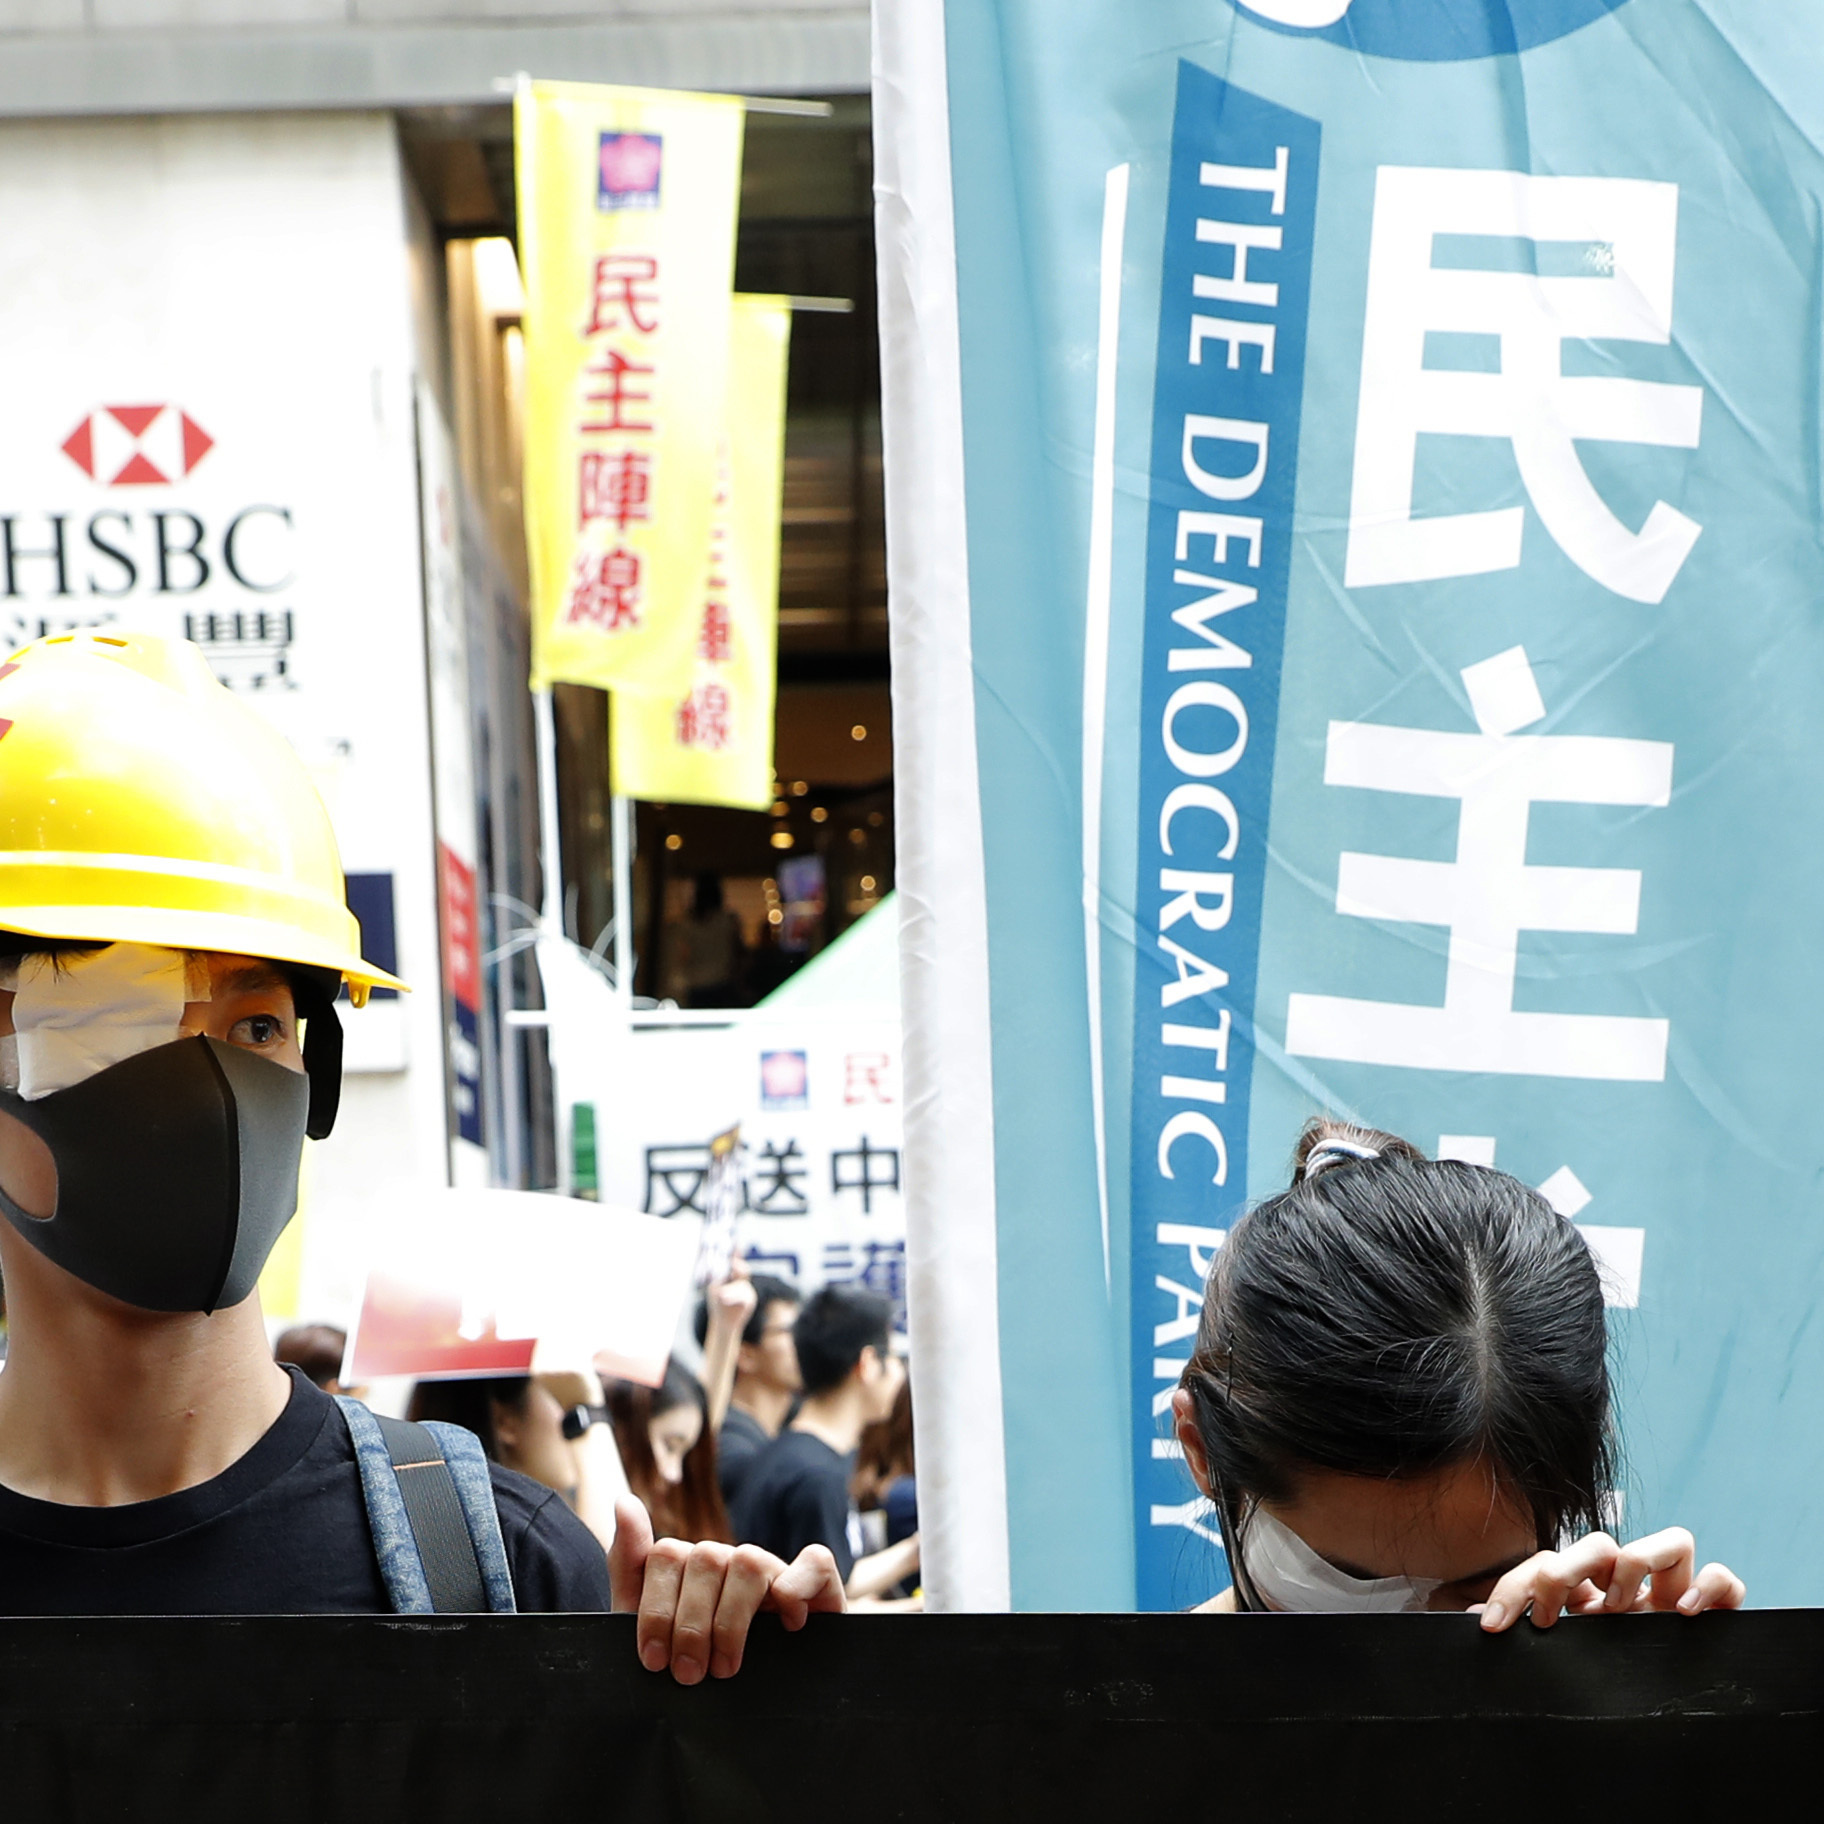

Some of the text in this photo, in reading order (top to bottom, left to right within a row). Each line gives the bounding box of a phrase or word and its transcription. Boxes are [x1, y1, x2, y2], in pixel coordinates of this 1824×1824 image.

[1187, 146, 1289, 375] THE
[566, 253, 661, 632] 民主陣線
[1155, 412, 1270, 1187] DEMOCRATIC
[641, 1133, 901, 1218] 反送中
